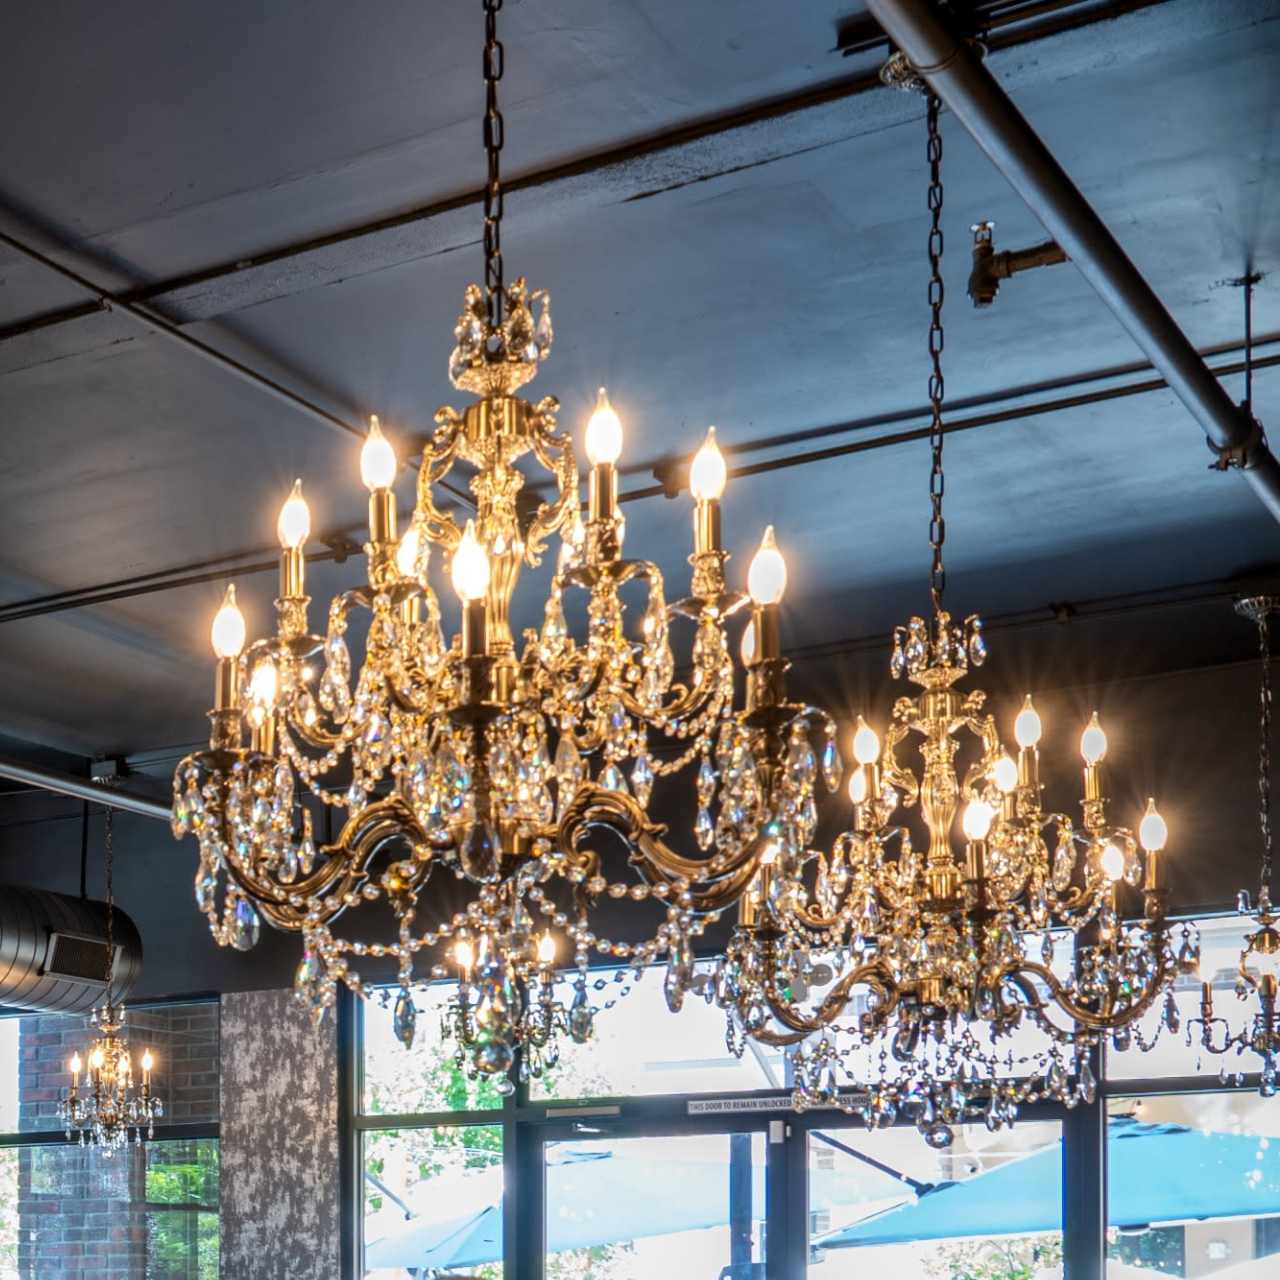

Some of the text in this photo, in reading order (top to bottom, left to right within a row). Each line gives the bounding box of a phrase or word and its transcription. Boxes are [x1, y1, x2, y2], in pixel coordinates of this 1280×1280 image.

[689, 1102, 704, 1111] THIS
[705, 1101, 722, 1110] DOOR
[732, 1100, 757, 1109] REMAIN
